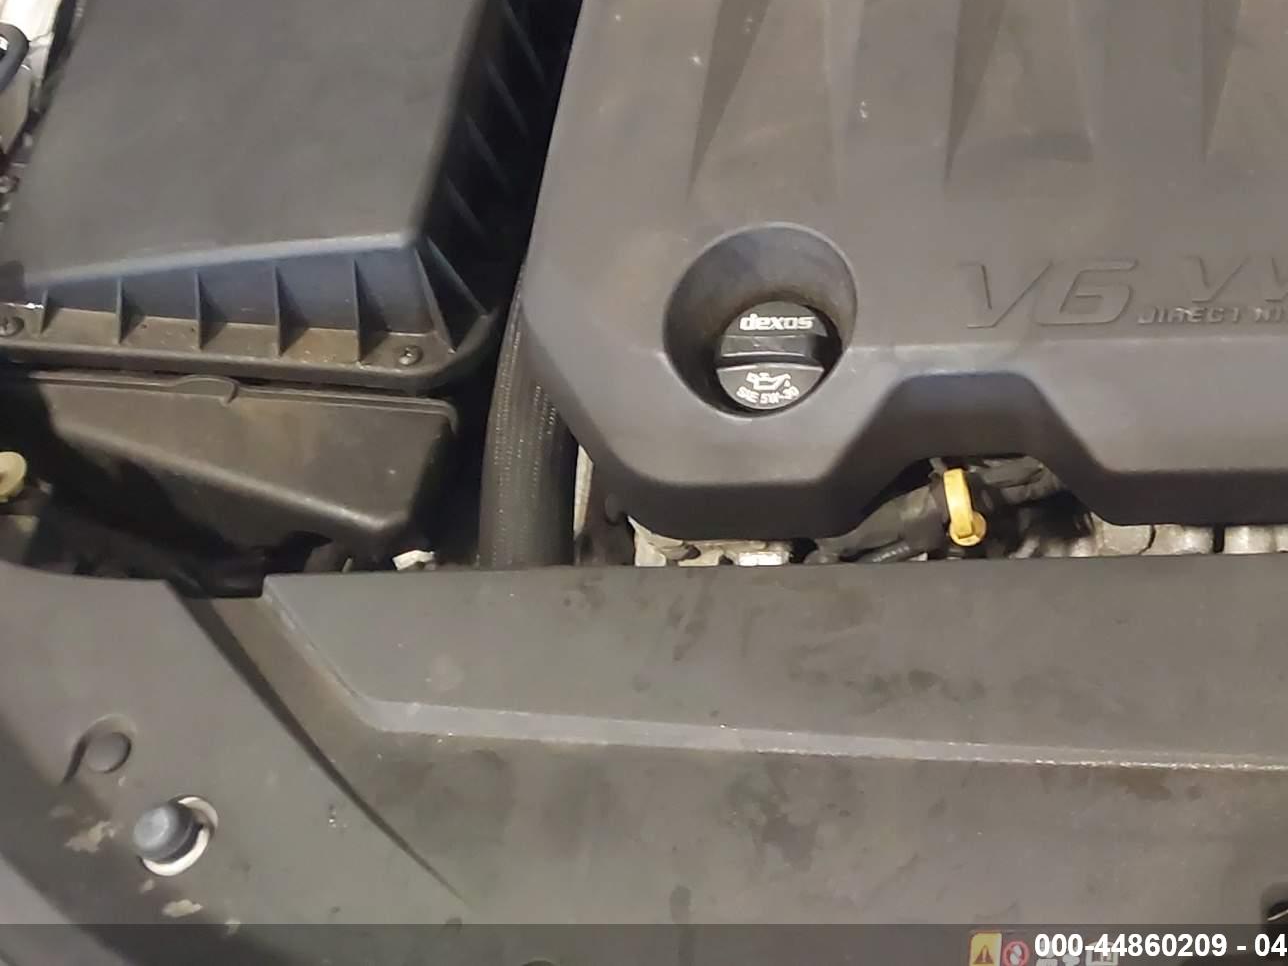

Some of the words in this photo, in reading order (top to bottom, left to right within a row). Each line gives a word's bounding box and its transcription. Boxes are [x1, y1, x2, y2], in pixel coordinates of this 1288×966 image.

[959, 258, 1140, 329] V6
[739, 313, 816, 331] dexos
[1137, 305, 1242, 325] DIRECT
[736, 386, 761, 404] SAE
